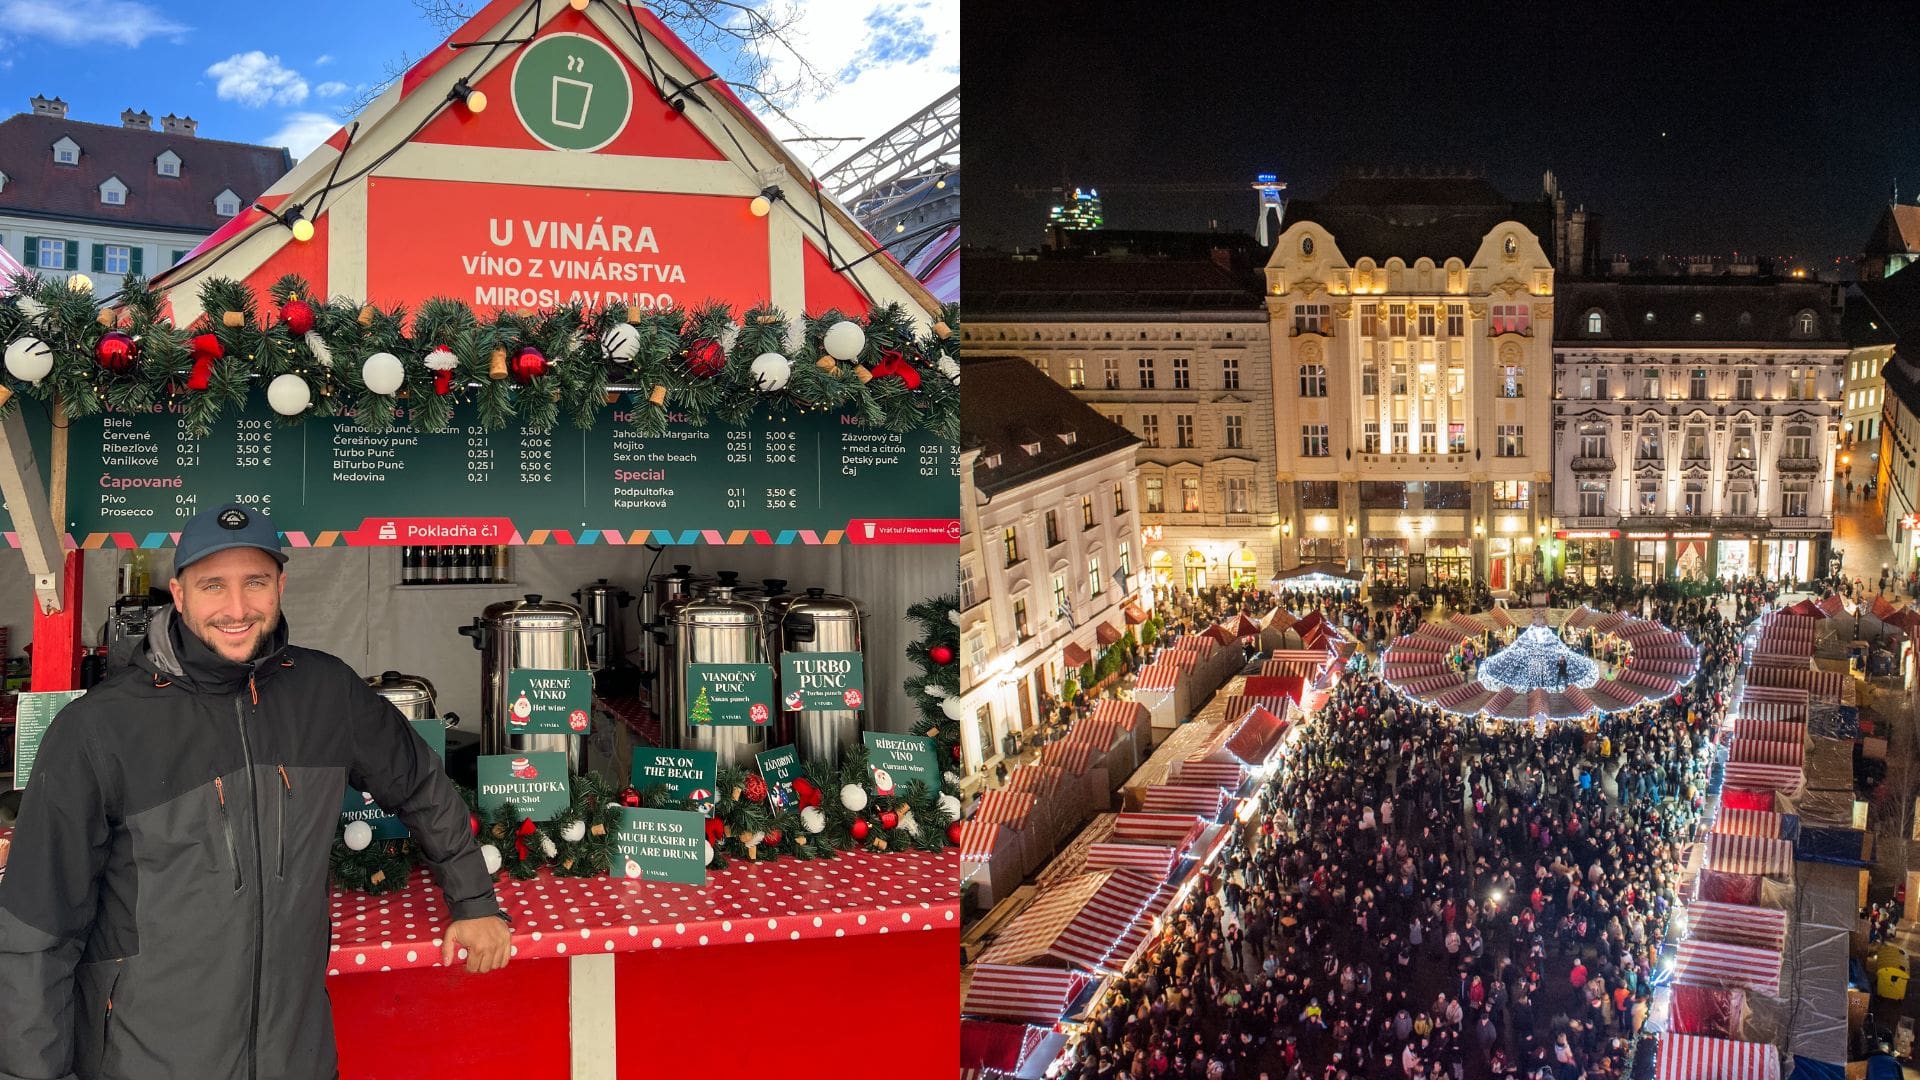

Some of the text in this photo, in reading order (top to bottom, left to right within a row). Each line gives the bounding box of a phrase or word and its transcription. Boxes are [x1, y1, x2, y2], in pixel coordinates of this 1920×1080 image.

[489, 217, 660, 254] U VINÁRA
[461, 251, 686, 283] VÍNO Z VINÁRSTVA
[475, 286, 600, 309] MIROSLAV
[103, 418, 133, 428] Biele
[237, 420, 260, 430] 3,00
[263, 420, 272, 429] €
[385, 424, 413, 435] punč
[468, 427, 483, 436] 0,2
[520, 427, 541, 436] 3,50
[544, 428, 552, 436] €
[102, 430, 272, 442] Červené 0,2 3,00 €
[333, 436, 552, 448] Čerešňový punč 0,2 4,00 €
[662, 431, 710, 441] Margarita
[727, 431, 747, 441] 0,25
[766, 432, 786, 441] 5,00
[788, 432, 796, 440] €
[842, 433, 902, 443] Zázvorový čaj
[177, 444, 194, 454] 0,2
[236, 445, 259, 455] 3,50
[263, 445, 272, 454] €
[613, 442, 796, 452] Mojito 0,25 5,00 €
[849, 445, 869, 453] med
[880, 445, 906, 453] citrón
[920, 446, 938, 454] 0,25
[333, 448, 552, 460] Turbo Punč 0,25 5,00 €
[613, 453, 632, 462] Sex
[648, 453, 665, 462] the
[667, 453, 697, 462] beach
[727, 454, 747, 463] 0,25
[766, 455, 786, 464] 5,00
[788, 455, 796, 463] €
[102, 456, 272, 467] Vanilkové 0,2 3,50 €
[333, 460, 552, 471] BiTurbo Punč 0,25 6,50 €
[842, 456, 873, 465] Detský
[875, 456, 898, 465] punč
[920, 457, 933, 465] 0,2
[614, 469, 665, 483] Special
[842, 465, 857, 476] Čaj
[920, 468, 933, 476] 0,2
[100, 473, 183, 490] Čapované
[333, 472, 552, 483] Medovina 0,2 3,50 €
[614, 488, 796, 498] Podpultofka 0,1 3,50 €
[101, 494, 127, 504] Pivo
[235, 494, 259, 505] 3,00
[262, 495, 272, 504] €
[614, 499, 796, 509] Kapurková 0,1 3,50 €
[101, 507, 154, 517] Prosecco
[175, 507, 190, 518] 0,1
[408, 524, 498, 537] Pokladňa č.1
[793, 660, 851, 674] TURBO
[702, 671, 757, 682] VIANOČNÝ
[800, 672, 846, 688] PUNČ
[529, 677, 571, 689] VARENÉ
[715, 682, 745, 692] PUNČ
[533, 688, 566, 700] VÍNKO
[890, 750, 913, 761] VÍNO
[655, 756, 694, 768] SEX ON
[644, 766, 704, 780] THE BEACH
[483, 781, 565, 795] PODPULTOFKA
[521, 795, 540, 803] Shot
[632, 820, 682, 833] LIFE IS SO
[617, 832, 699, 847] MUCH EASIER IF
[617, 845, 698, 860] YOU ARE DRUNK
